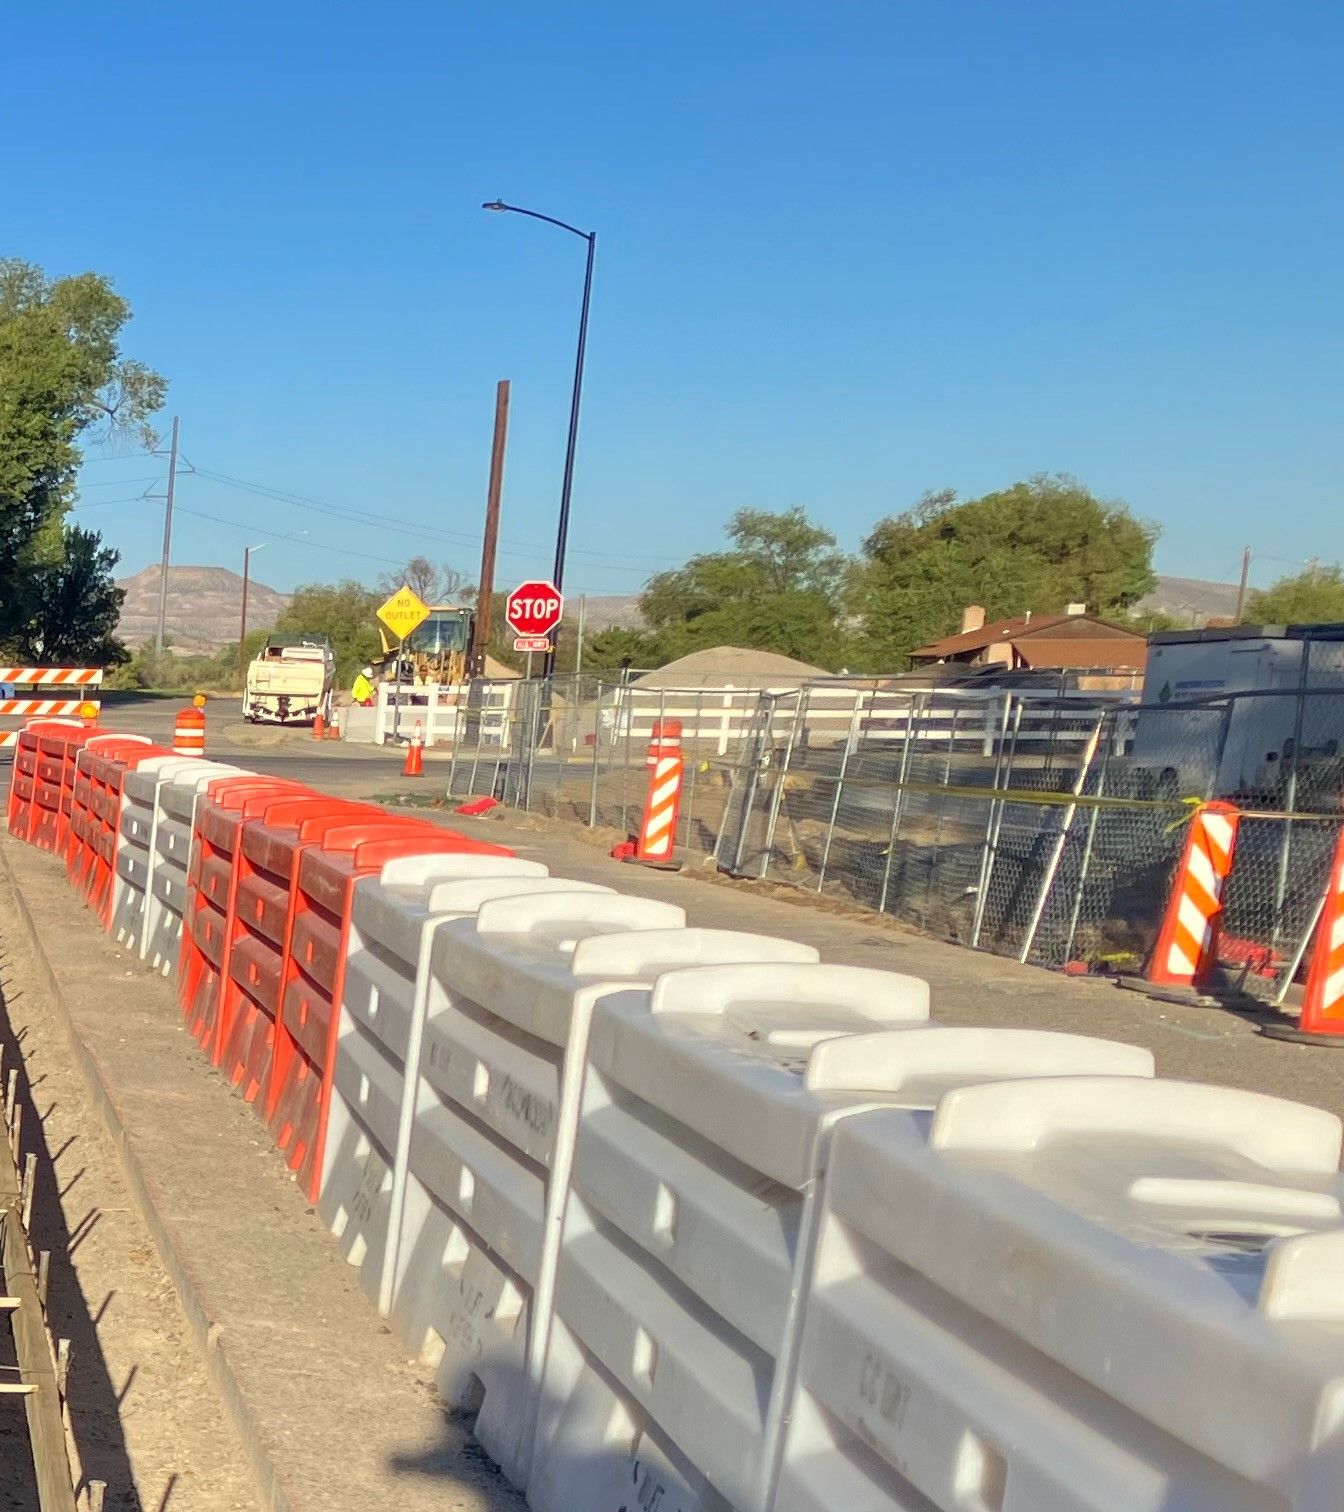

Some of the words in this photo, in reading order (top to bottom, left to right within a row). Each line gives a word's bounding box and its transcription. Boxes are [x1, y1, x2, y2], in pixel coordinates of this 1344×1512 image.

[397, 599, 411, 607] NO
[509, 598, 559, 619] STOP
[385, 611, 421, 620] OUTLET
